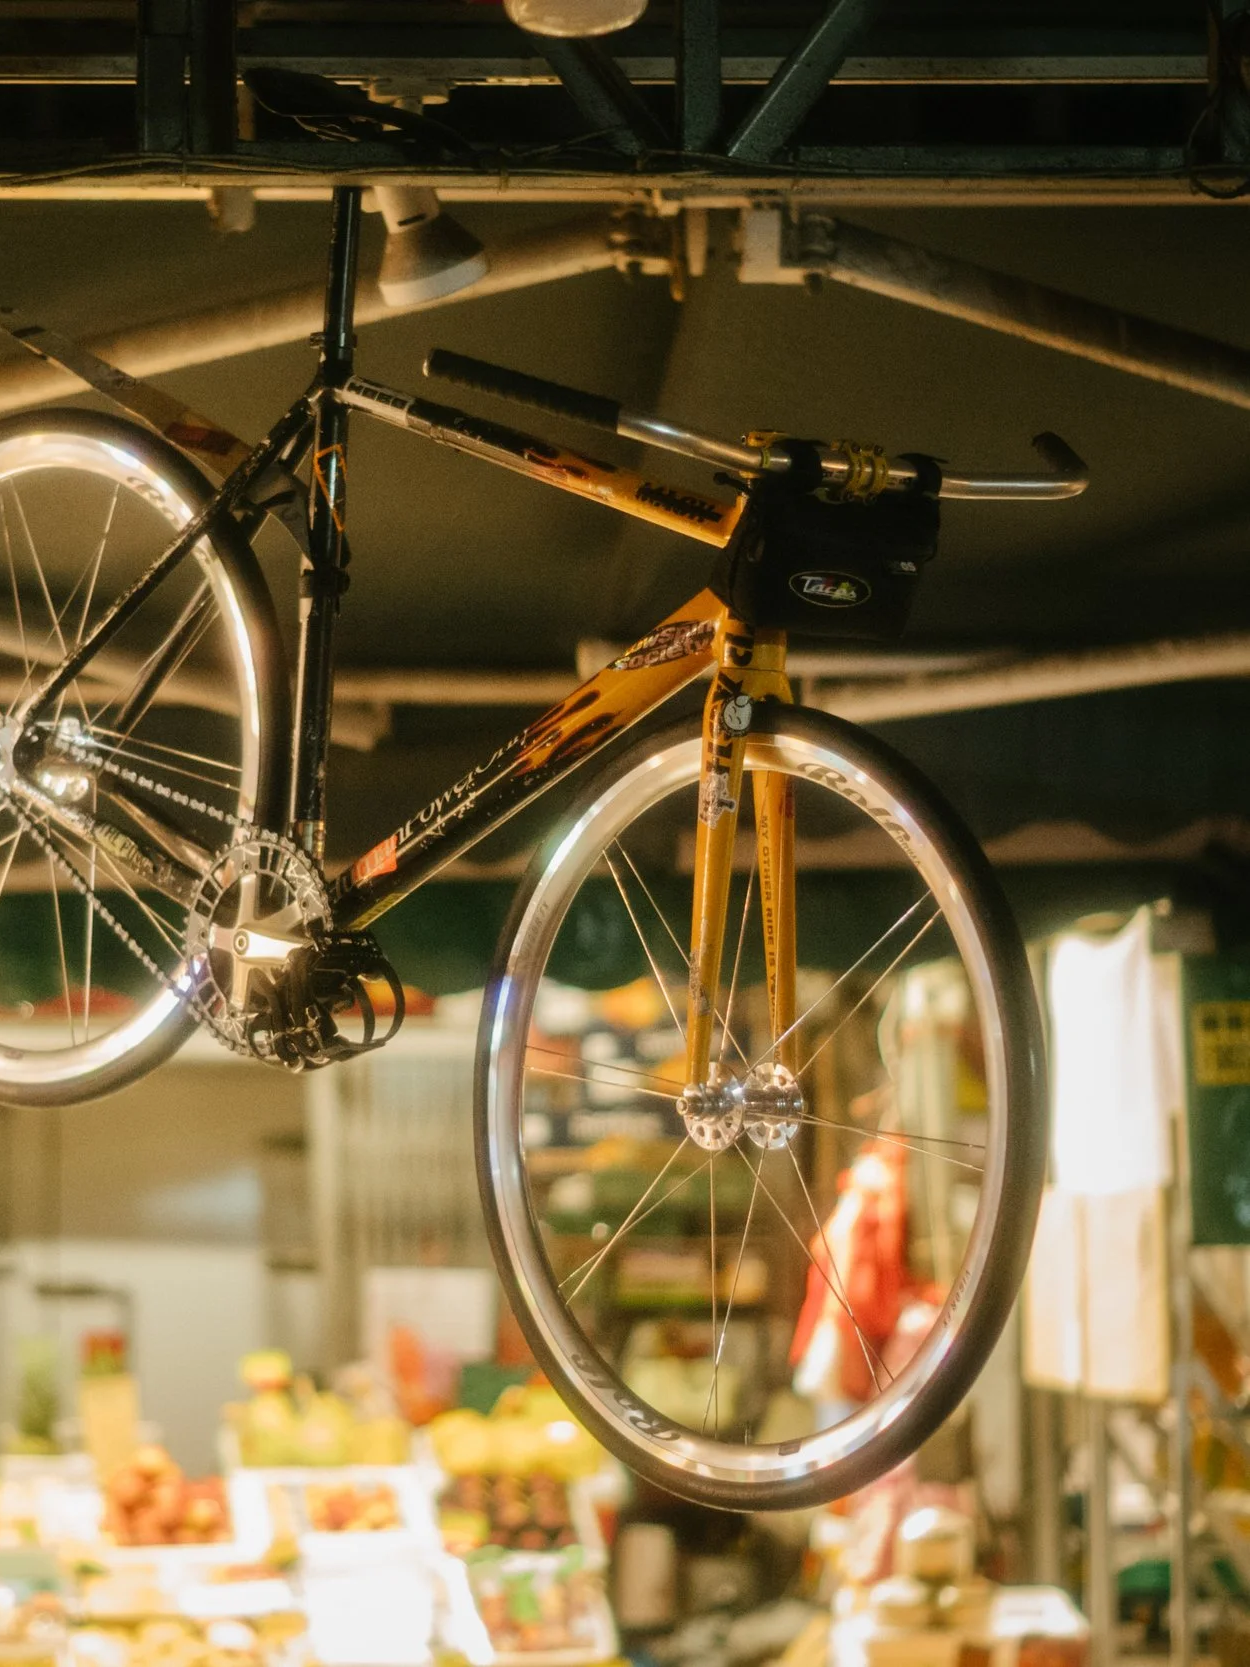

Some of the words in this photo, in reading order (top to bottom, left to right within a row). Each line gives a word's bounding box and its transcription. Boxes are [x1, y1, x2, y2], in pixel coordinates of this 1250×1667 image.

[760, 815, 769, 840] MY
[762, 846, 772, 901] OTHER
[765, 907, 775, 946] RIDE
[768, 951, 775, 966] IS
